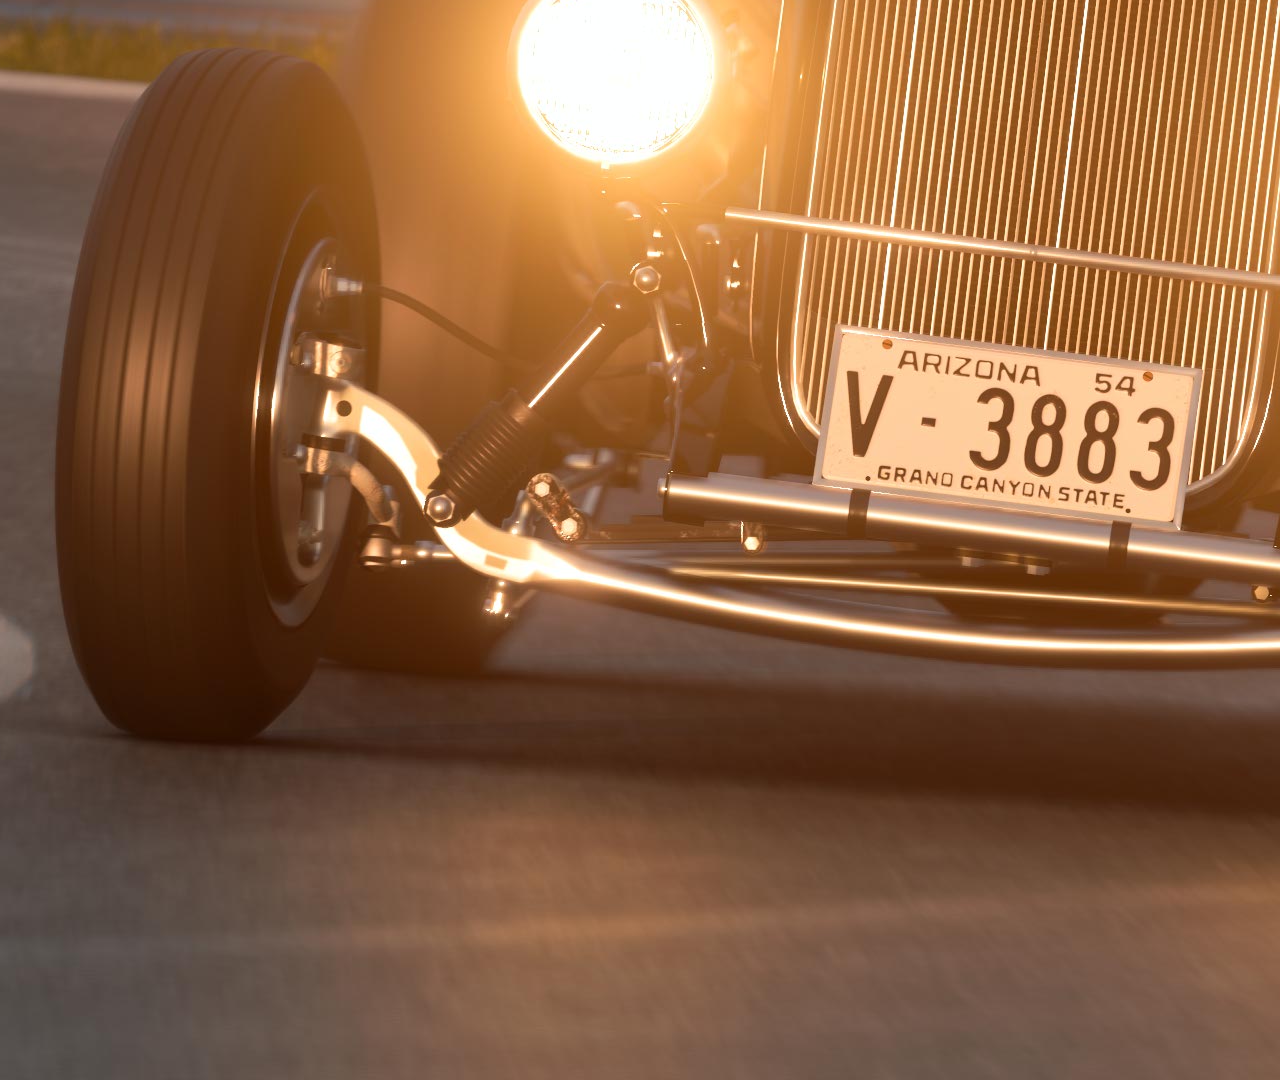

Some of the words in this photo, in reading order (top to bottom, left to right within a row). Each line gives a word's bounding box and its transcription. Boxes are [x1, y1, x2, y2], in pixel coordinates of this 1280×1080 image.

[897, 350, 1041, 387] ARIZONA
[1094, 372, 1136, 397] 54
[968, 387, 1176, 492] 3883
[877, 465, 955, 489] GRAND
[960, 475, 1052, 501] CANYON
[1057, 486, 1126, 510] STATE
